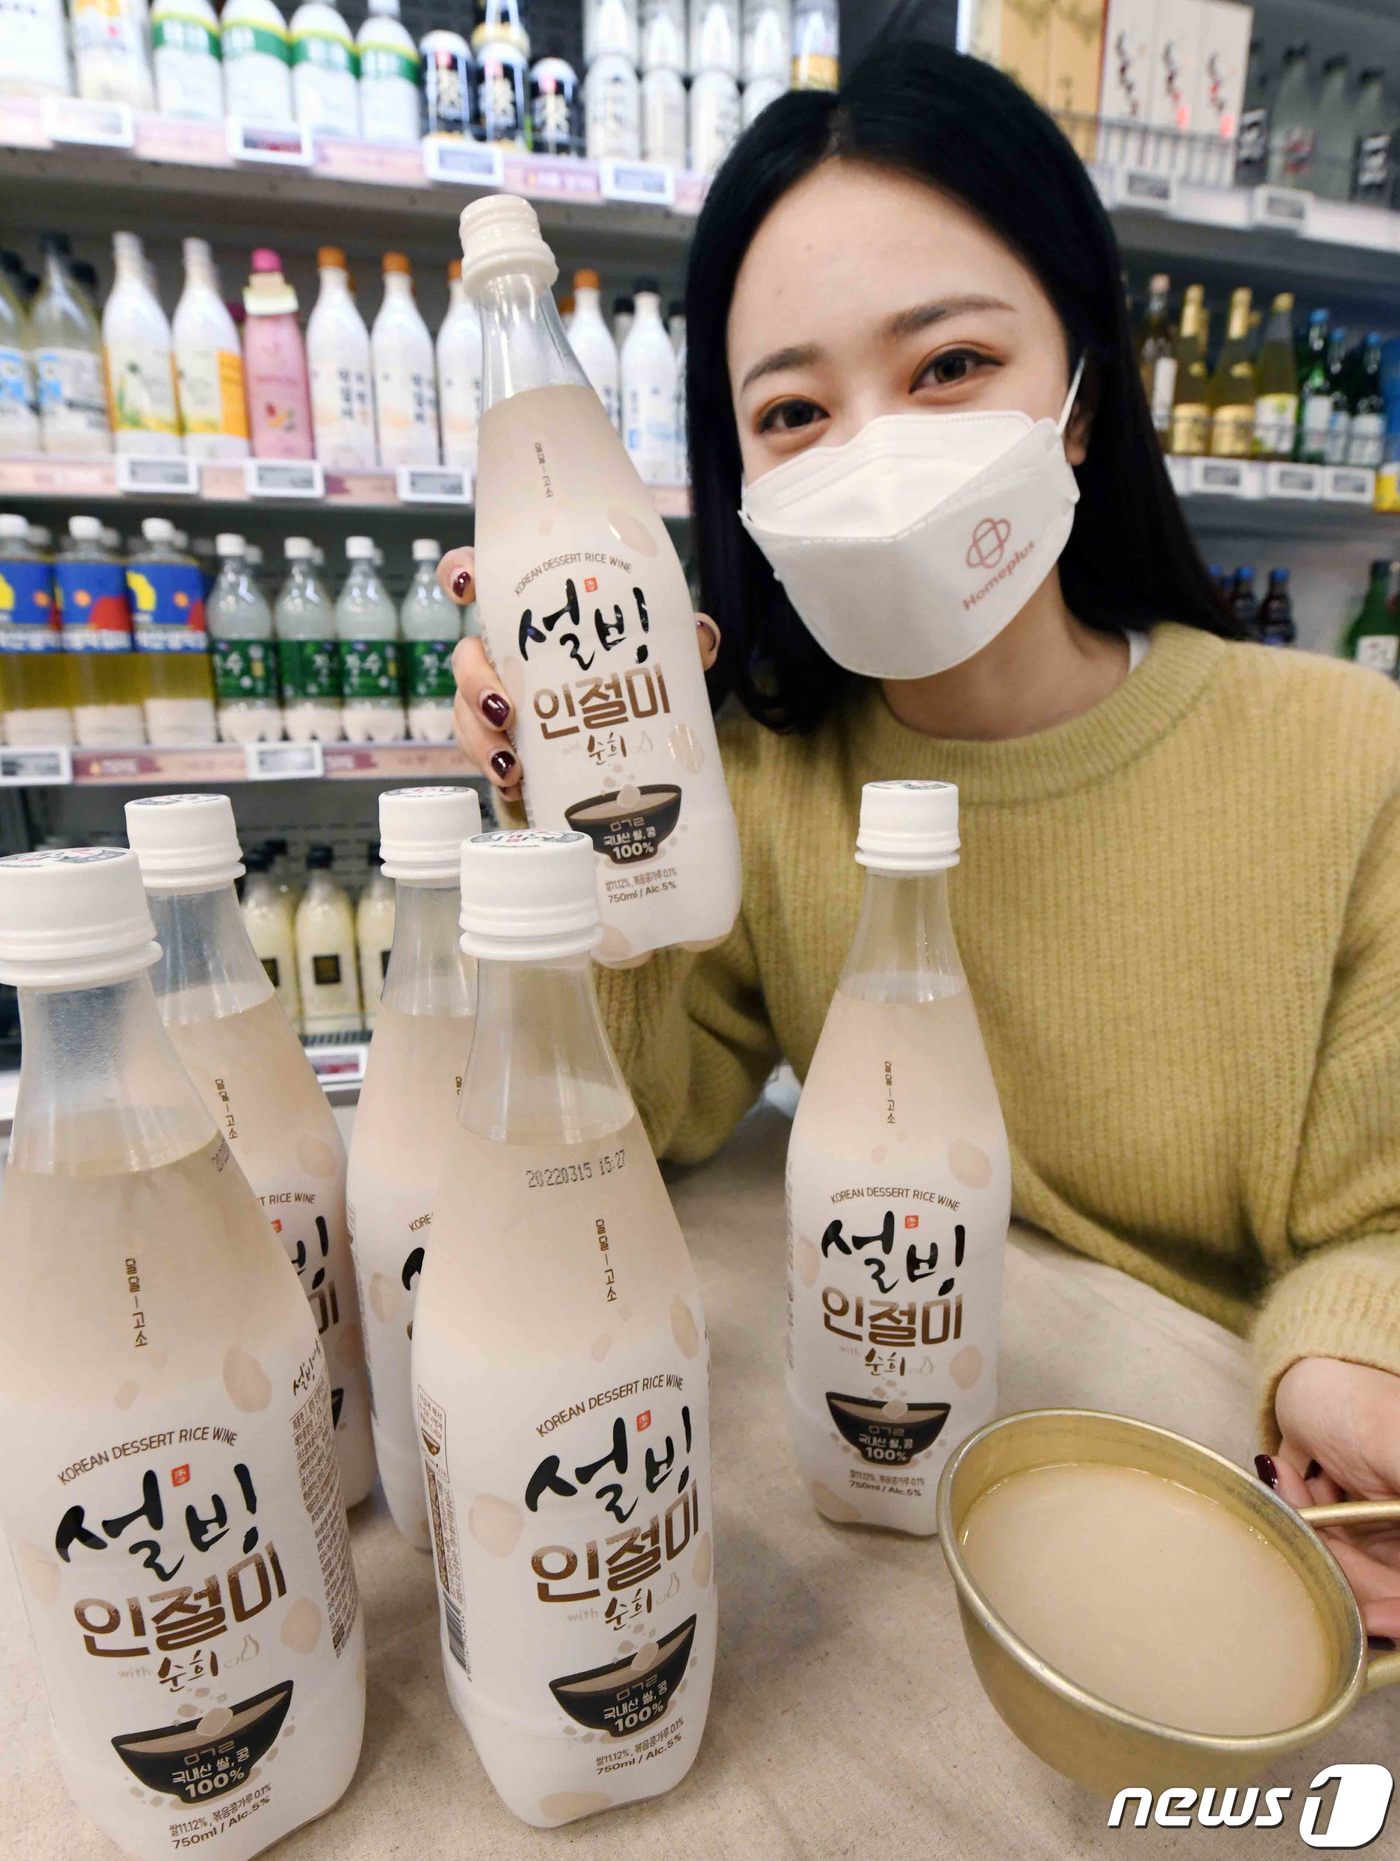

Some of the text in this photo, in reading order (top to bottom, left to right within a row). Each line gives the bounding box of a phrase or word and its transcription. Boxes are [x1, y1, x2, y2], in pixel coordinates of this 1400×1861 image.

[515, 552, 632, 596] KOREAN DESSERT RICE WINE
[963, 540, 1034, 610] Homeplus
[518, 578, 649, 671] 설빙
[533, 663, 671, 740] 인절미
[587, 731, 627, 766] 순희
[612, 841, 655, 860] 100%
[608, 890, 637, 904] 750ml
[645, 880, 677, 895] Alc.5%
[525, 1149, 626, 1188] 20220315 15:27
[269, 1193, 291, 1206] RICE
[294, 1192, 316, 1206] WINE
[831, 1186, 961, 1212] KOREAN DESSERT RICE WINE
[408, 1212, 434, 1232] KORE
[291, 1215, 328, 1290] 빙
[821, 1210, 966, 1297] 설빙
[821, 1286, 963, 1347] 인절미
[865, 1348, 905, 1377] 순희
[536, 1374, 684, 1437] KOREAN DESSERT RICE WINE
[57, 1426, 238, 1486] KOREAN DESSERT RICE WINE
[525, 1406, 692, 1524] 설빙
[865, 1446, 907, 1462] 100%
[850, 1480, 880, 1492] 750ml
[888, 1485, 922, 1497] Alc.5%
[55, 1463, 259, 1582] 설빙
[531, 1478, 699, 1603] 인절미
[74, 1541, 288, 1658] 인절미
[604, 1588, 653, 1631] 순희
[157, 1649, 219, 1693] 순희
[603, 1697, 639, 1720] 국내산
[614, 1700, 664, 1732] 100%
[596, 1758, 636, 1775] 750ml
[645, 1733, 682, 1760] Alc.5%
[634, 1727, 671, 1753] 볶음콩가루
[171, 1765, 213, 1785] 국내산
[184, 1767, 245, 1798] 100%
[171, 1827, 218, 1849] 750ml
[228, 1796, 271, 1828] Alc.5%
[212, 1793, 254, 1822] 볶음콩가루
